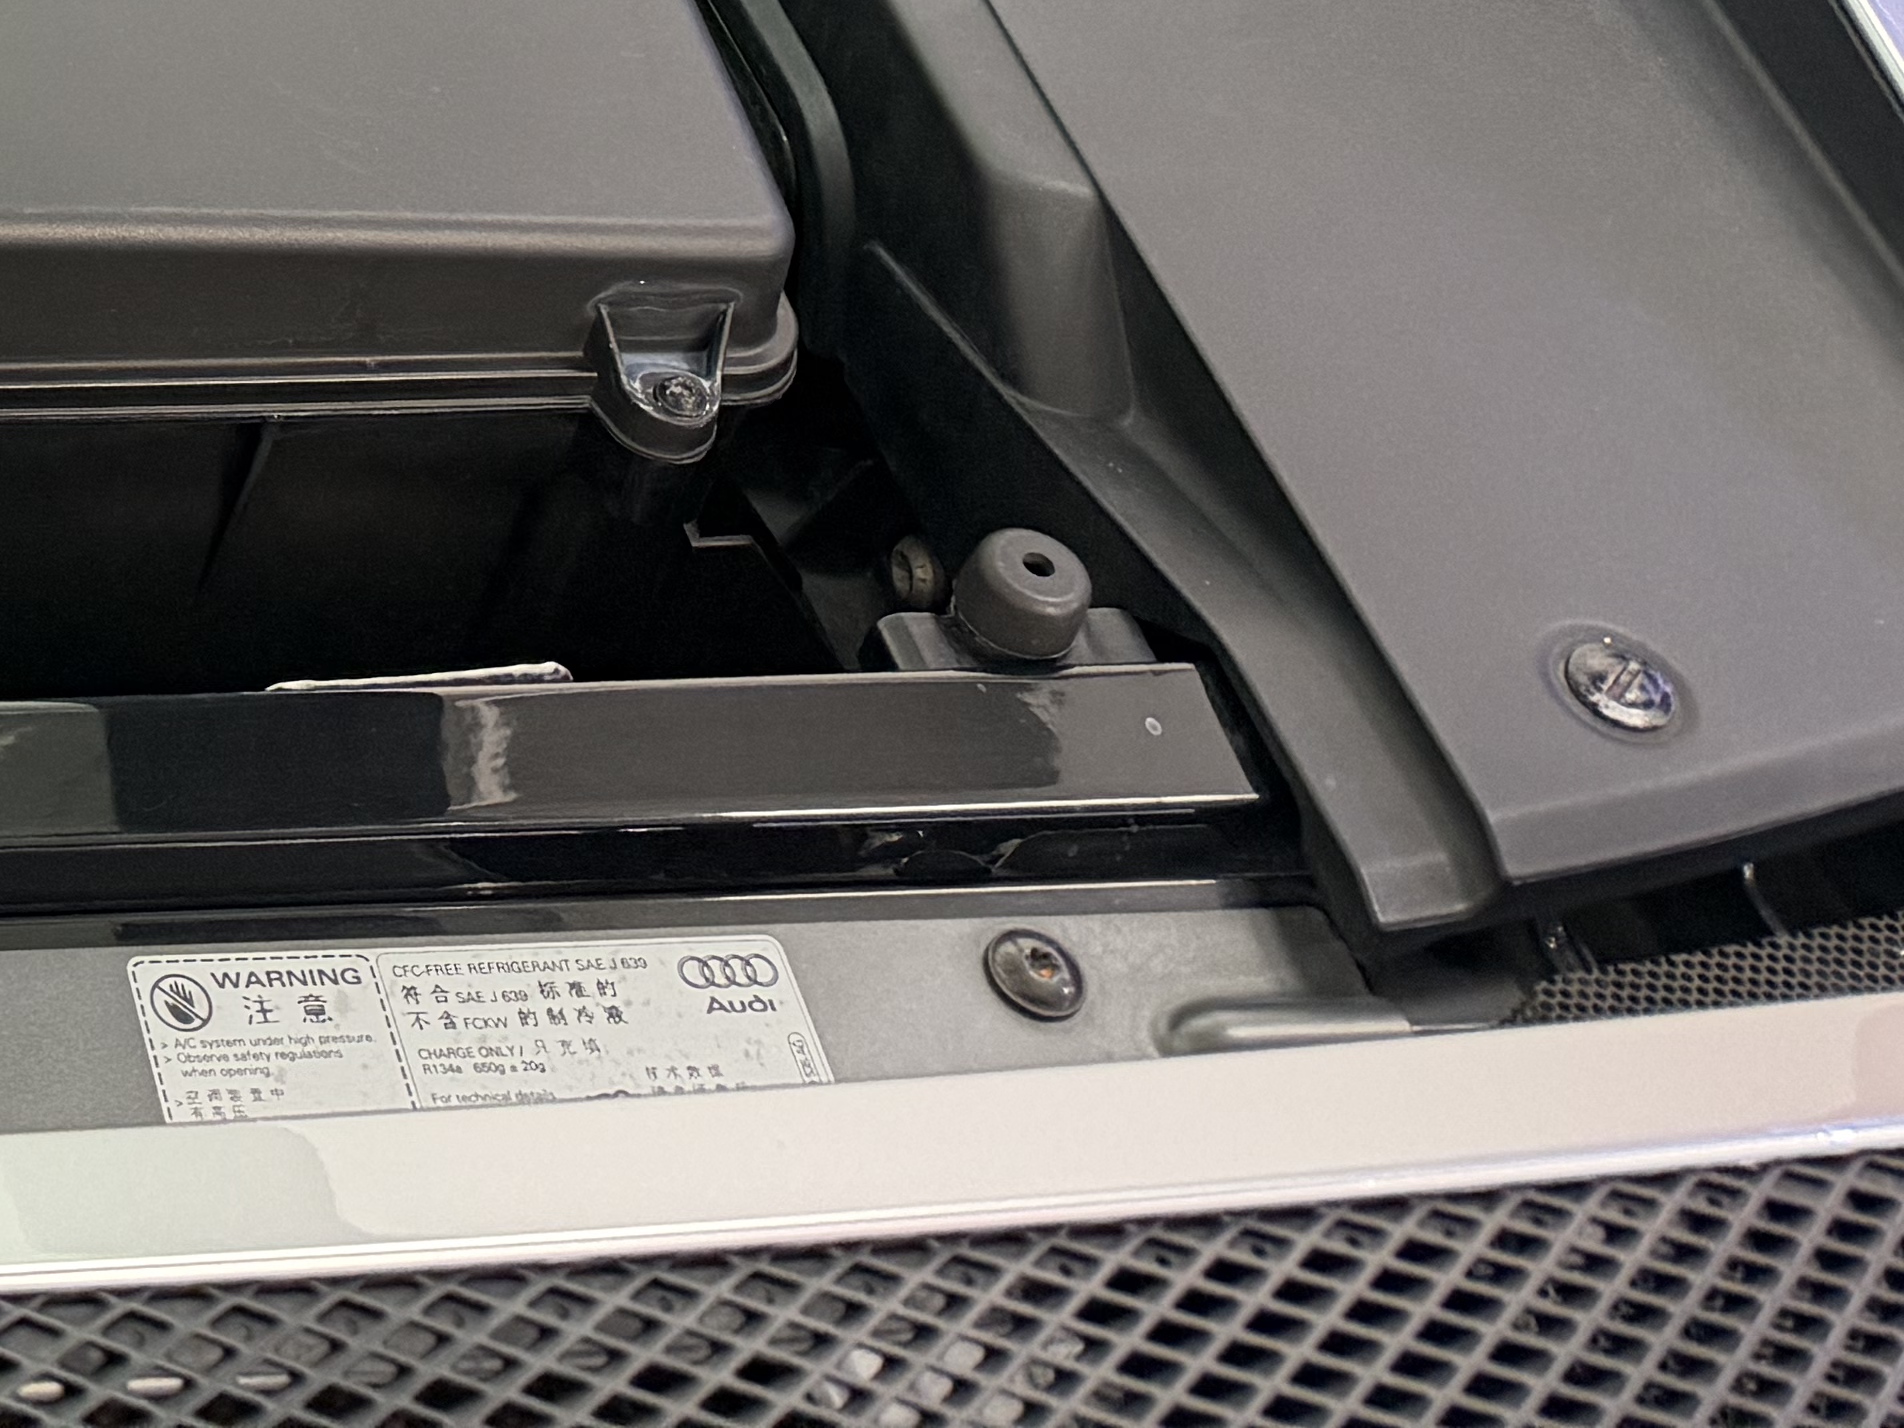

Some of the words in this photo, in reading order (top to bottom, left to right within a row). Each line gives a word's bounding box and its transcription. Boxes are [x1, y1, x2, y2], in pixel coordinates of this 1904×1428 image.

[392, 962, 464, 978] CFC-FREE
[467, 958, 572, 975] REFRIGERANT
[575, 957, 603, 971] SAE
[210, 967, 363, 989] WARNING
[455, 990, 486, 1004] SAE
[706, 994, 777, 1014] Audi
[242, 993, 333, 1026] 注意
[463, 1015, 509, 1030] FCKW
[174, 1038, 197, 1050] A/C
[199, 1038, 245, 1050] system
[248, 1036, 284, 1047] under
[287, 1034, 314, 1047] high
[176, 1051, 230, 1064] Observe
[234, 1049, 271, 1063] safety
[274, 1048, 344, 1062] regulations
[417, 1046, 476, 1061] CHARGE
[181, 1067, 217, 1078] when
[422, 1061, 463, 1075] R134a
[472, 1061, 506, 1075] 650g
[521, 1060, 546, 1074] 20g
[430, 1092, 452, 1105] For
[455, 1089, 513, 1104] technical
